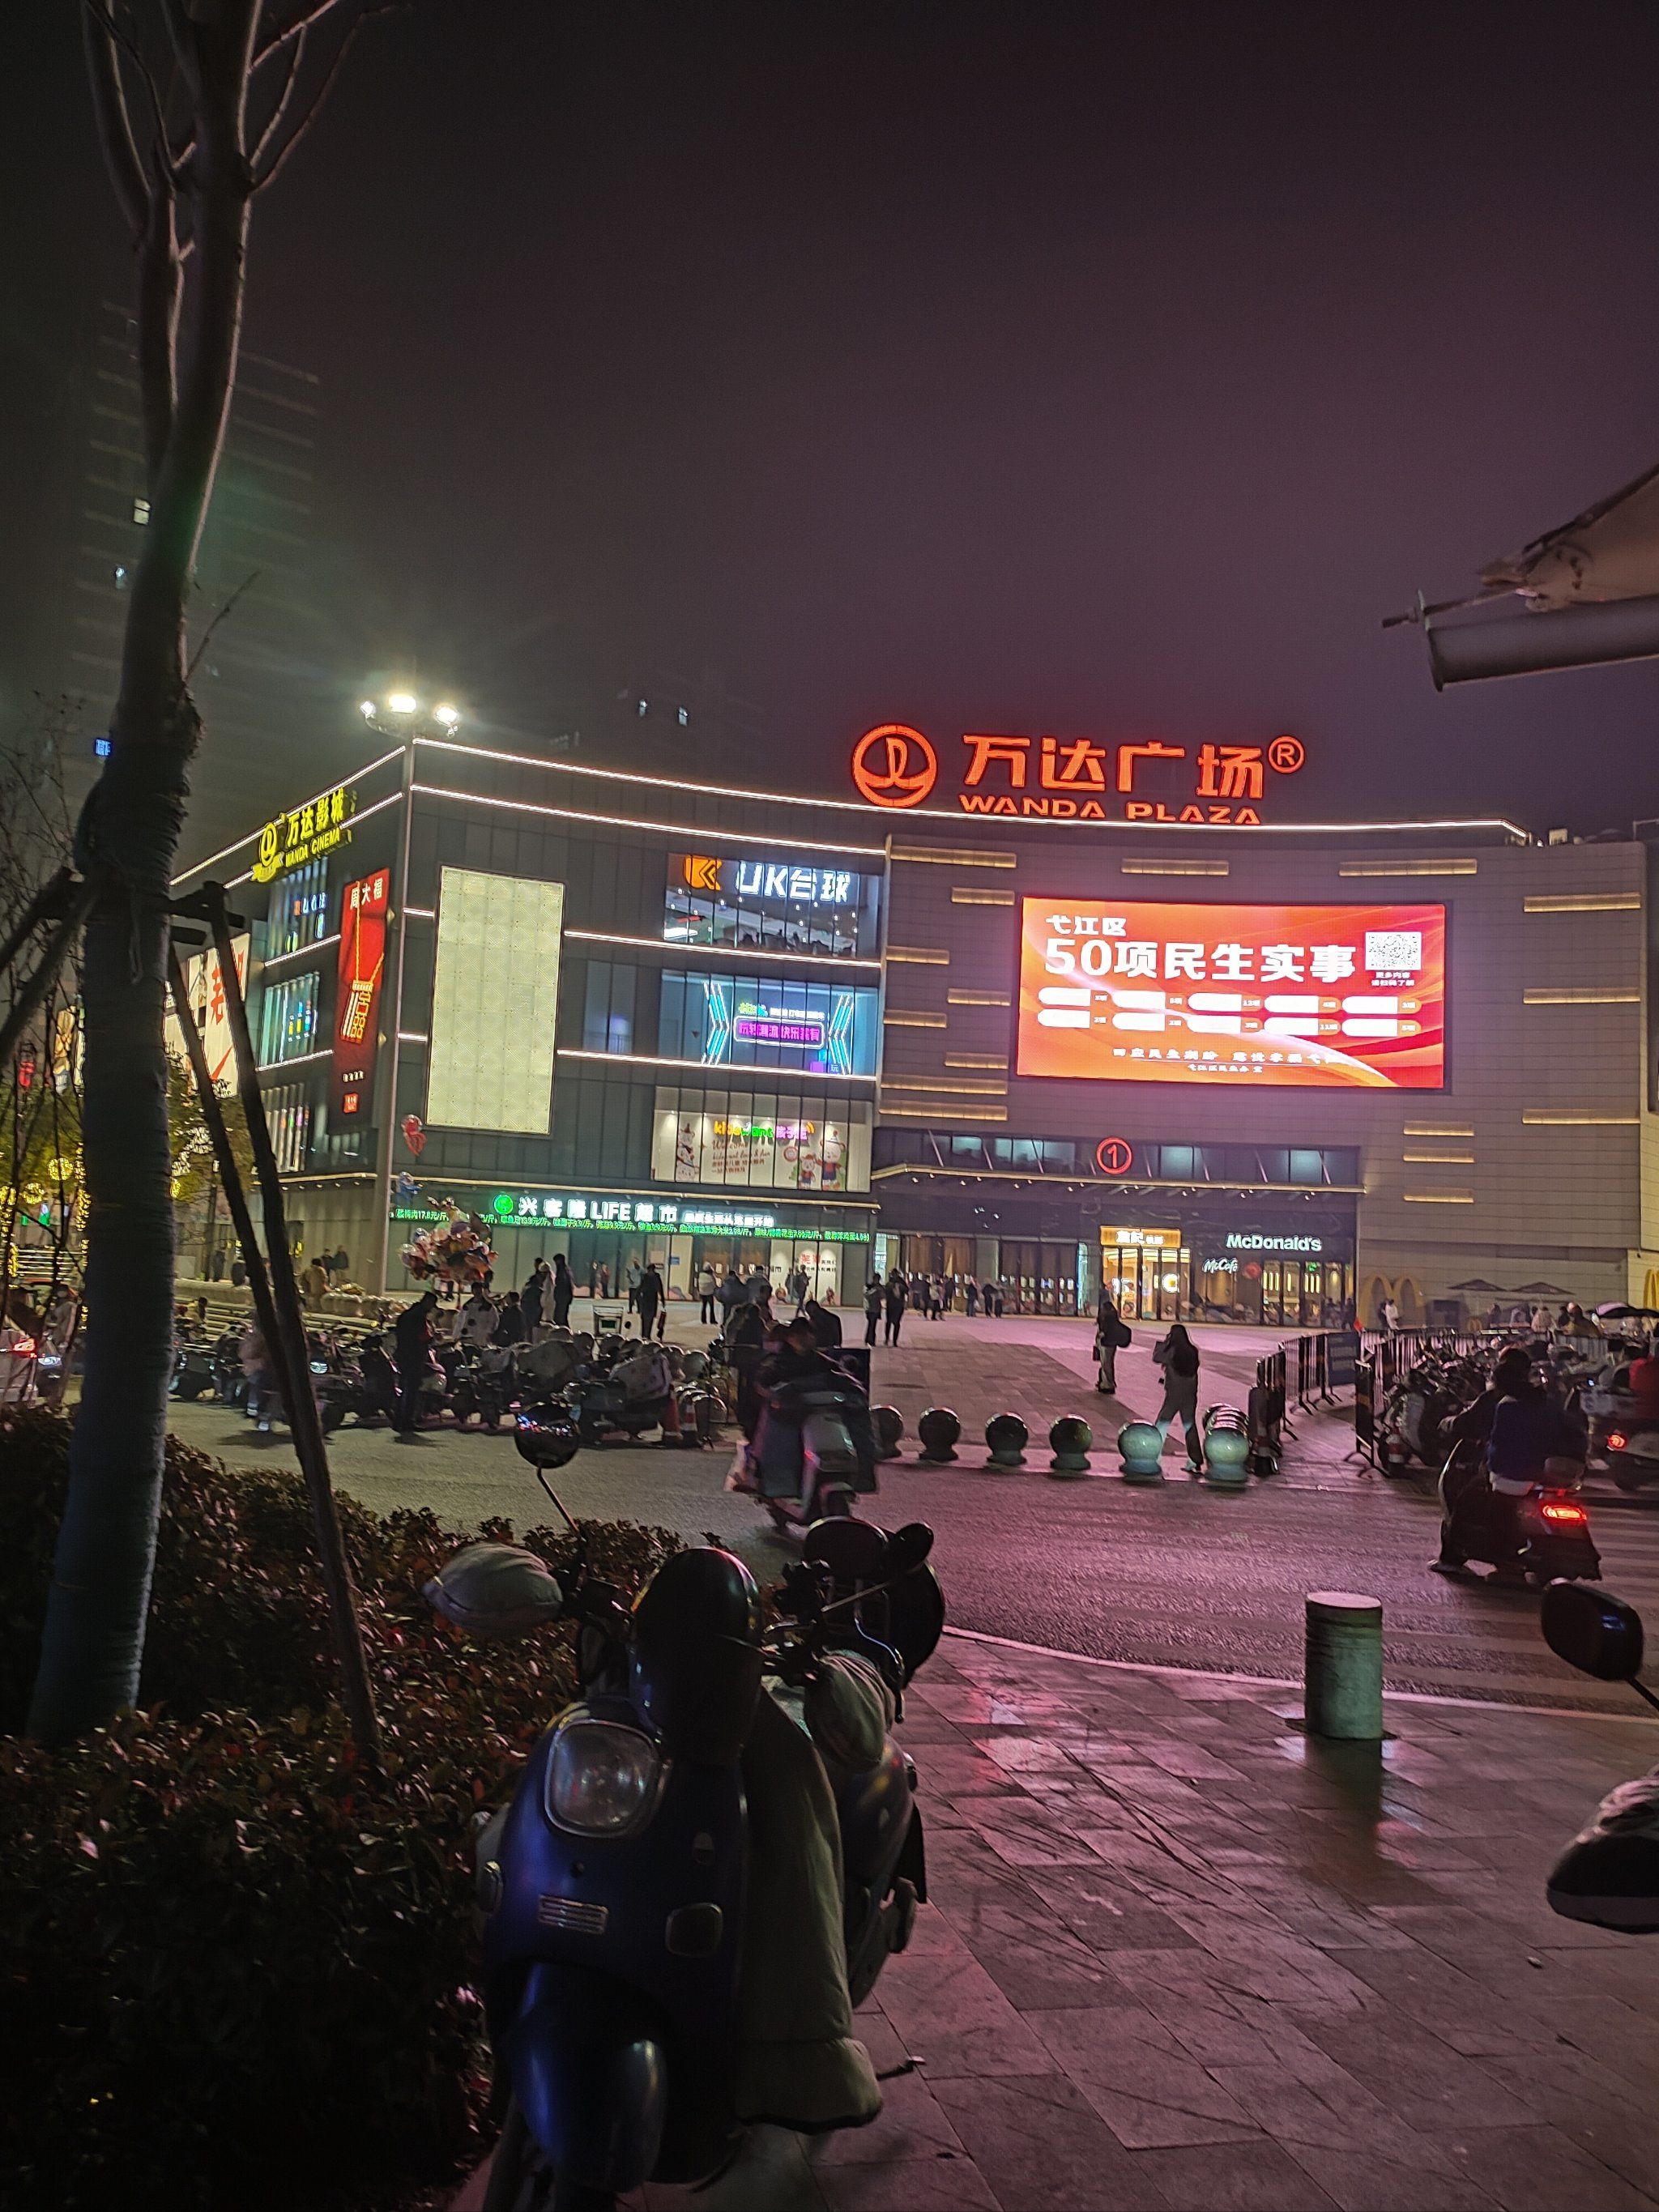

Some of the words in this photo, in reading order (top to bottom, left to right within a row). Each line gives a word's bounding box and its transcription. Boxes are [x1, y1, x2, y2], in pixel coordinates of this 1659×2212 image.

[964, 734, 1263, 799] 万达广场
[287, 787, 344, 847] 万达影城
[959, 794, 1107, 819] WANDA
[1126, 801, 1261, 825] PLAZA
[285, 844, 309, 867] WANDA
[311, 826, 340, 855] CINEMA
[350, 878, 383, 910] 周大福
[736, 860, 851, 903] UK台球
[1044, 938, 1356, 983] 50项民生实事
[590, 1201, 631, 1221] LIFE
[1226, 1233, 1322, 1252] McDonald's
